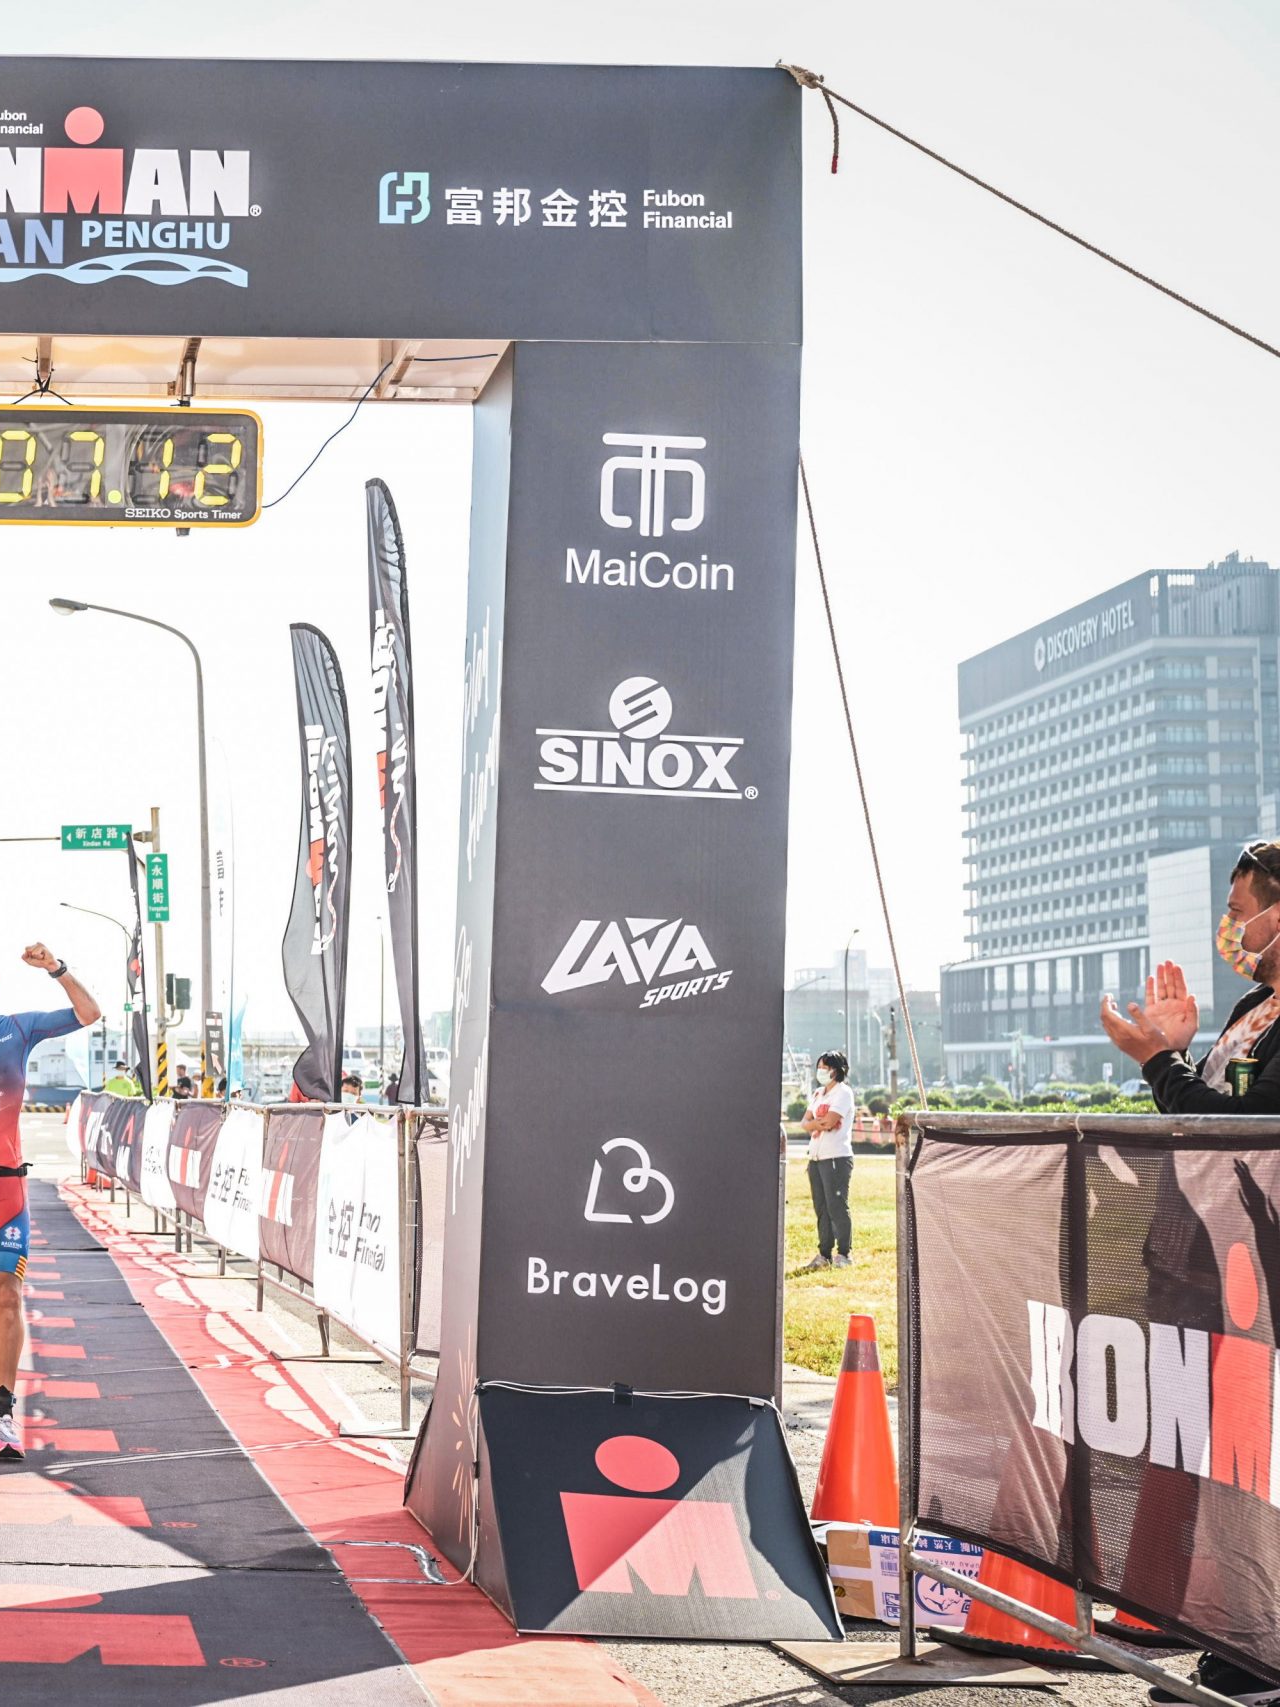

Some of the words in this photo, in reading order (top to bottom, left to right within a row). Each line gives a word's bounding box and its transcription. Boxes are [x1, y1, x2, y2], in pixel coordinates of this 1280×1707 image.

[444, 187, 628, 228] 富邦金控
[643, 189, 705, 207] Fubon
[81, 220, 230, 250] PENGHU
[643, 211, 733, 229] Financial
[124, 507, 171, 521] SEIKO
[173, 508, 209, 523] Sports
[211, 508, 243, 520] Timer
[565, 547, 734, 591] MaiCoin
[1046, 613, 1099, 663] DISCOVERY
[1101, 599, 1135, 639] HOTEL
[538, 738, 739, 791] SINOX
[75, 827, 119, 840] 新店路
[151, 864, 165, 904] 永順街
[540, 917, 718, 996] LAVA
[638, 970, 734, 1009] SPORTS
[527, 1256, 727, 1316] BraveLog
[1027, 1299, 1280, 1509] IRONM
